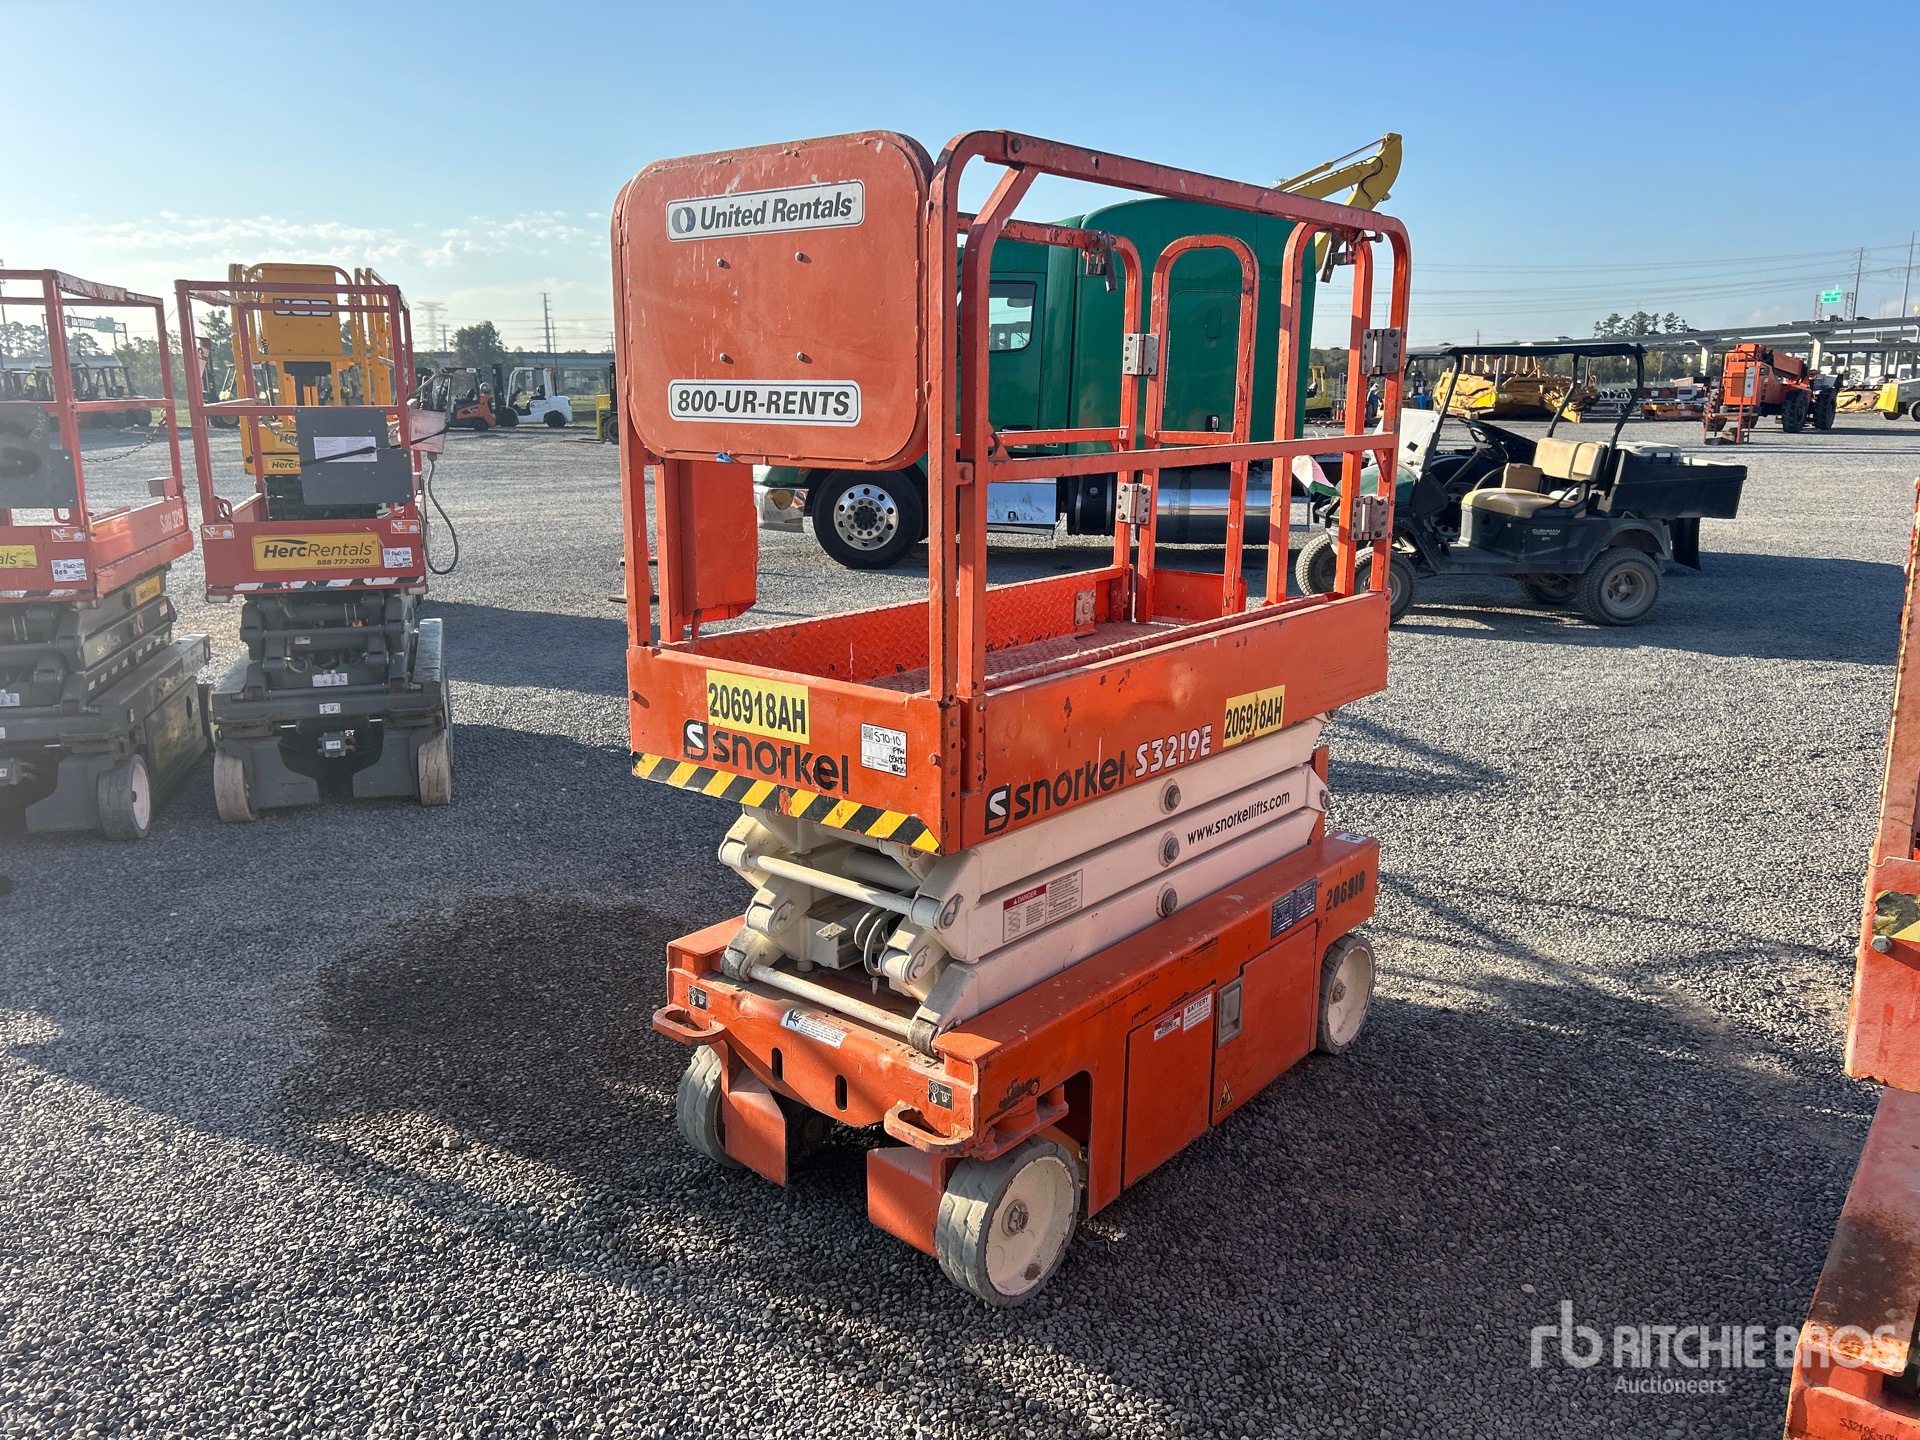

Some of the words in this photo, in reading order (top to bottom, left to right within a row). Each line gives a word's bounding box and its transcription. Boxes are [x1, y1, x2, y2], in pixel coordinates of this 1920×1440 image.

[700, 199, 767, 231] United
[771, 191, 853, 224] Rentals
[677, 389, 850, 416] 800-UR-RENTS
[263, 542, 372, 559] HercRentals
[316, 558, 370, 566] 888-777-2700
[708, 682, 806, 735] 206918AH
[1224, 695, 1284, 740] 206918AH
[712, 729, 850, 795] snorkel
[1135, 724, 1213, 779] S3219E
[1014, 750, 1126, 821] snorkel
[1187, 790, 1291, 846] www.snorkellifts.com
[1017, 889, 1038, 904] DANGER
[1187, 996, 1209, 1014] BATTERY
